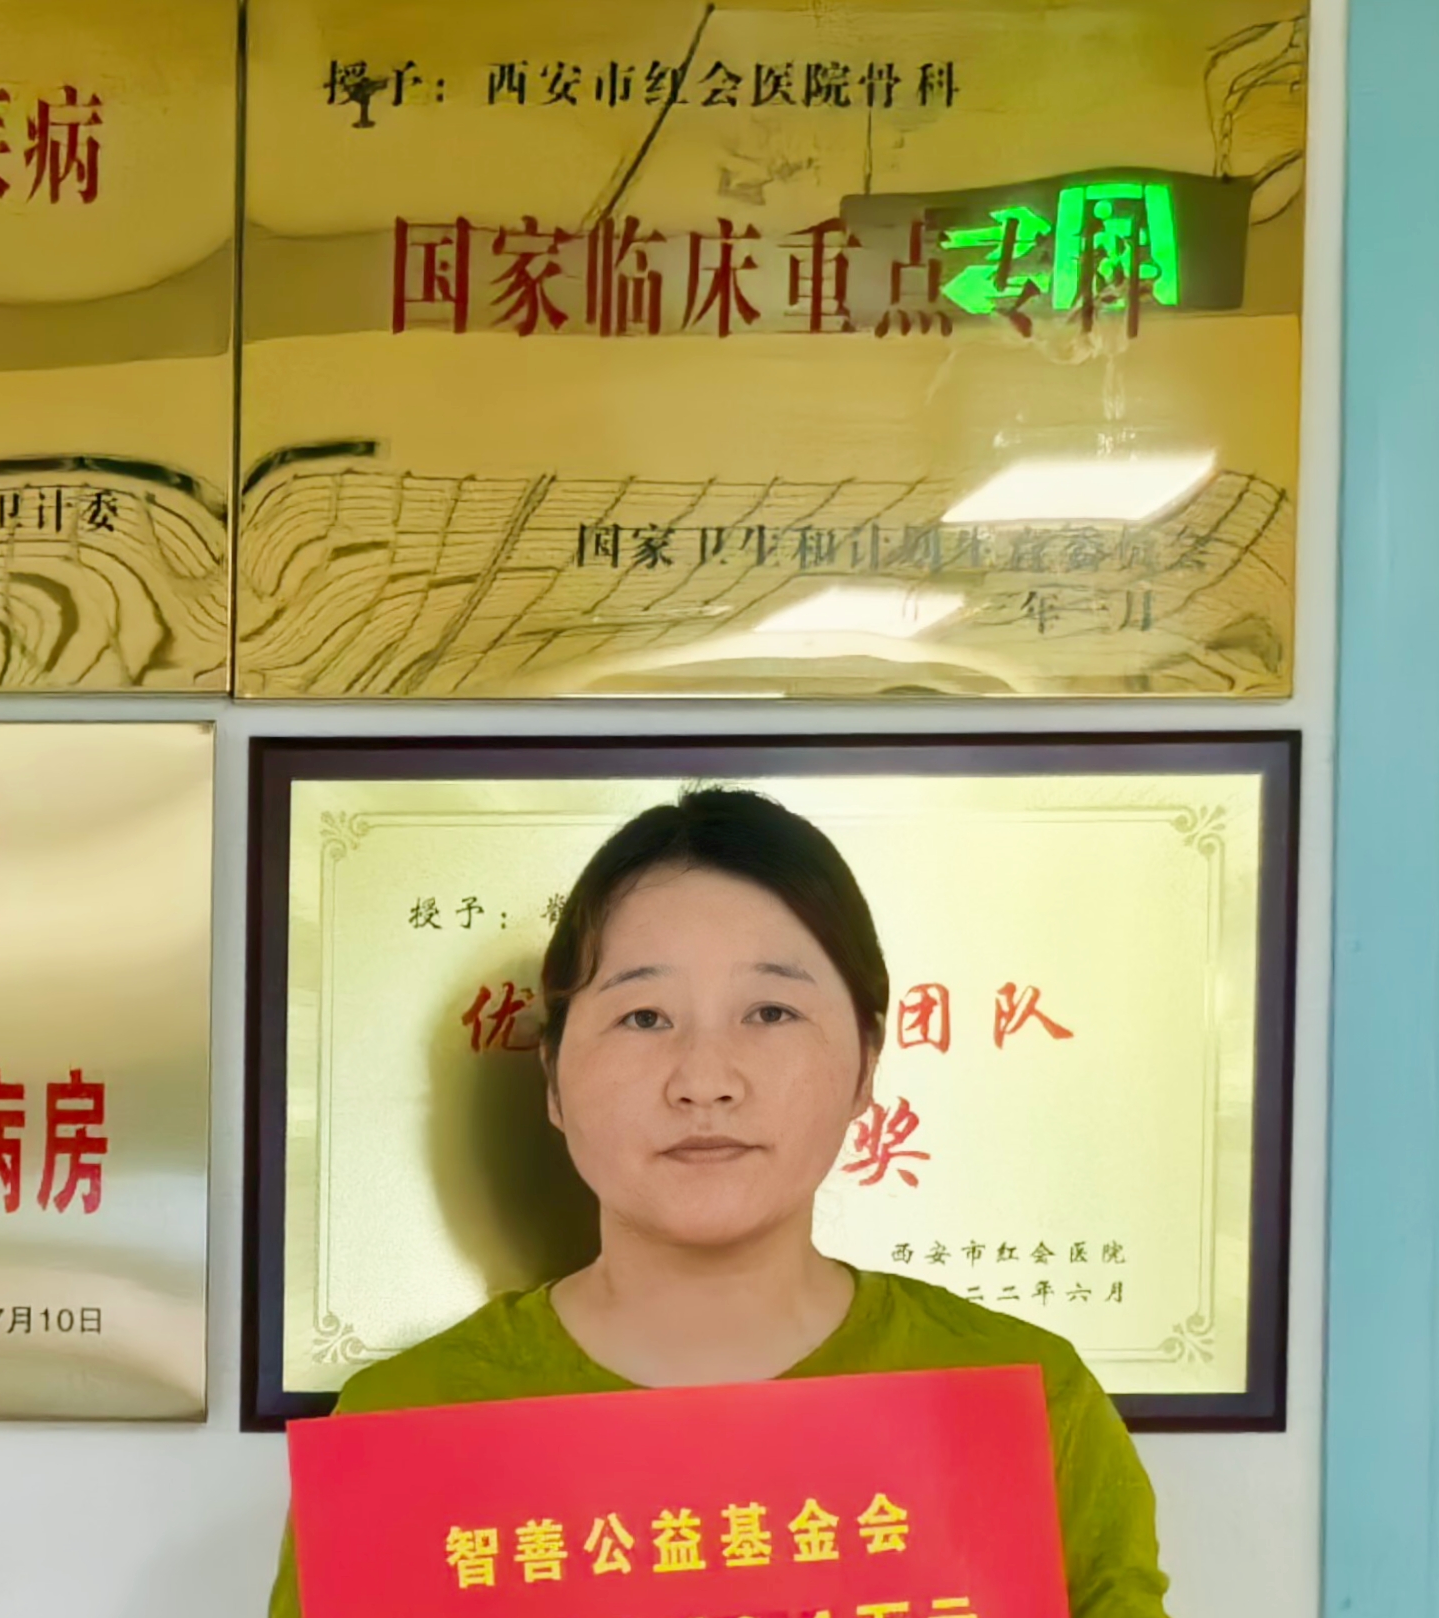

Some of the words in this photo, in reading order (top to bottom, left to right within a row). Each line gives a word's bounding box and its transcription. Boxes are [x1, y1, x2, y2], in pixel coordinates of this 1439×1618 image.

[391, 214, 1143, 340] 国家临床重点专科
[891, 1240, 1127, 1268] 西安市红会医院
[444, 1491, 911, 1589] 智善公益基金会
